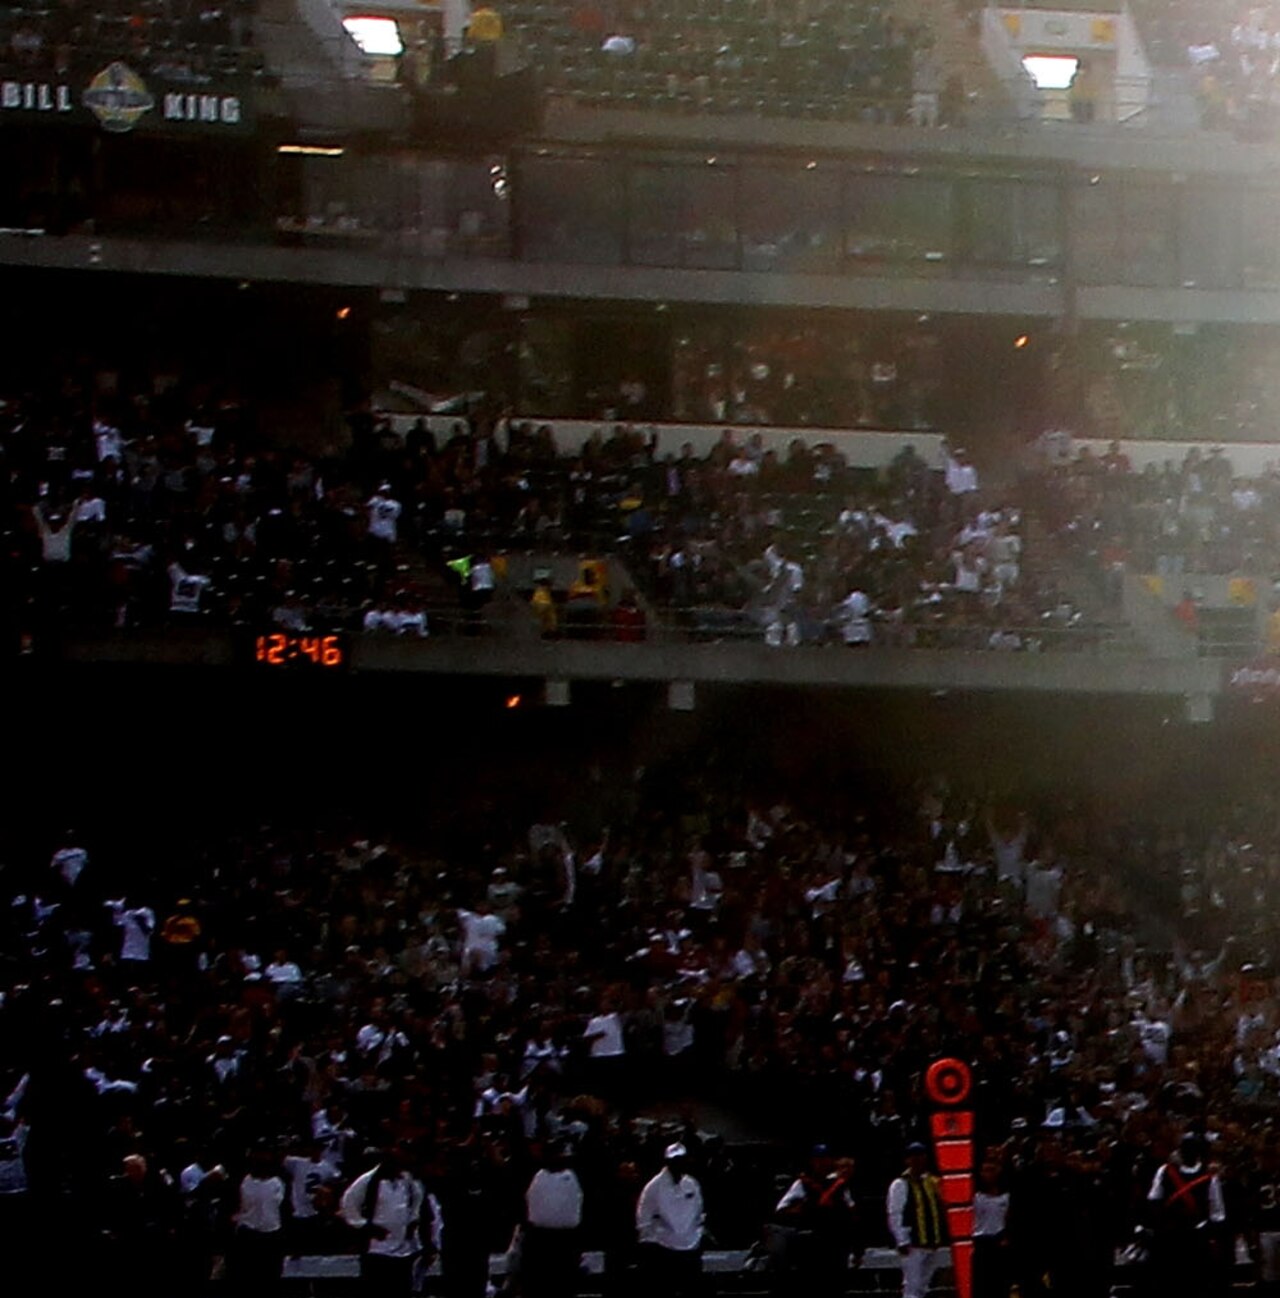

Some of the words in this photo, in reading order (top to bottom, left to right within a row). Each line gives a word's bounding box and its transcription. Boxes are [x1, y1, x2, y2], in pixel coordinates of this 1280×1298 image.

[1, 81, 72, 111] BILL
[163, 93, 241, 123] KING
[256, 633, 342, 666] 12:46
